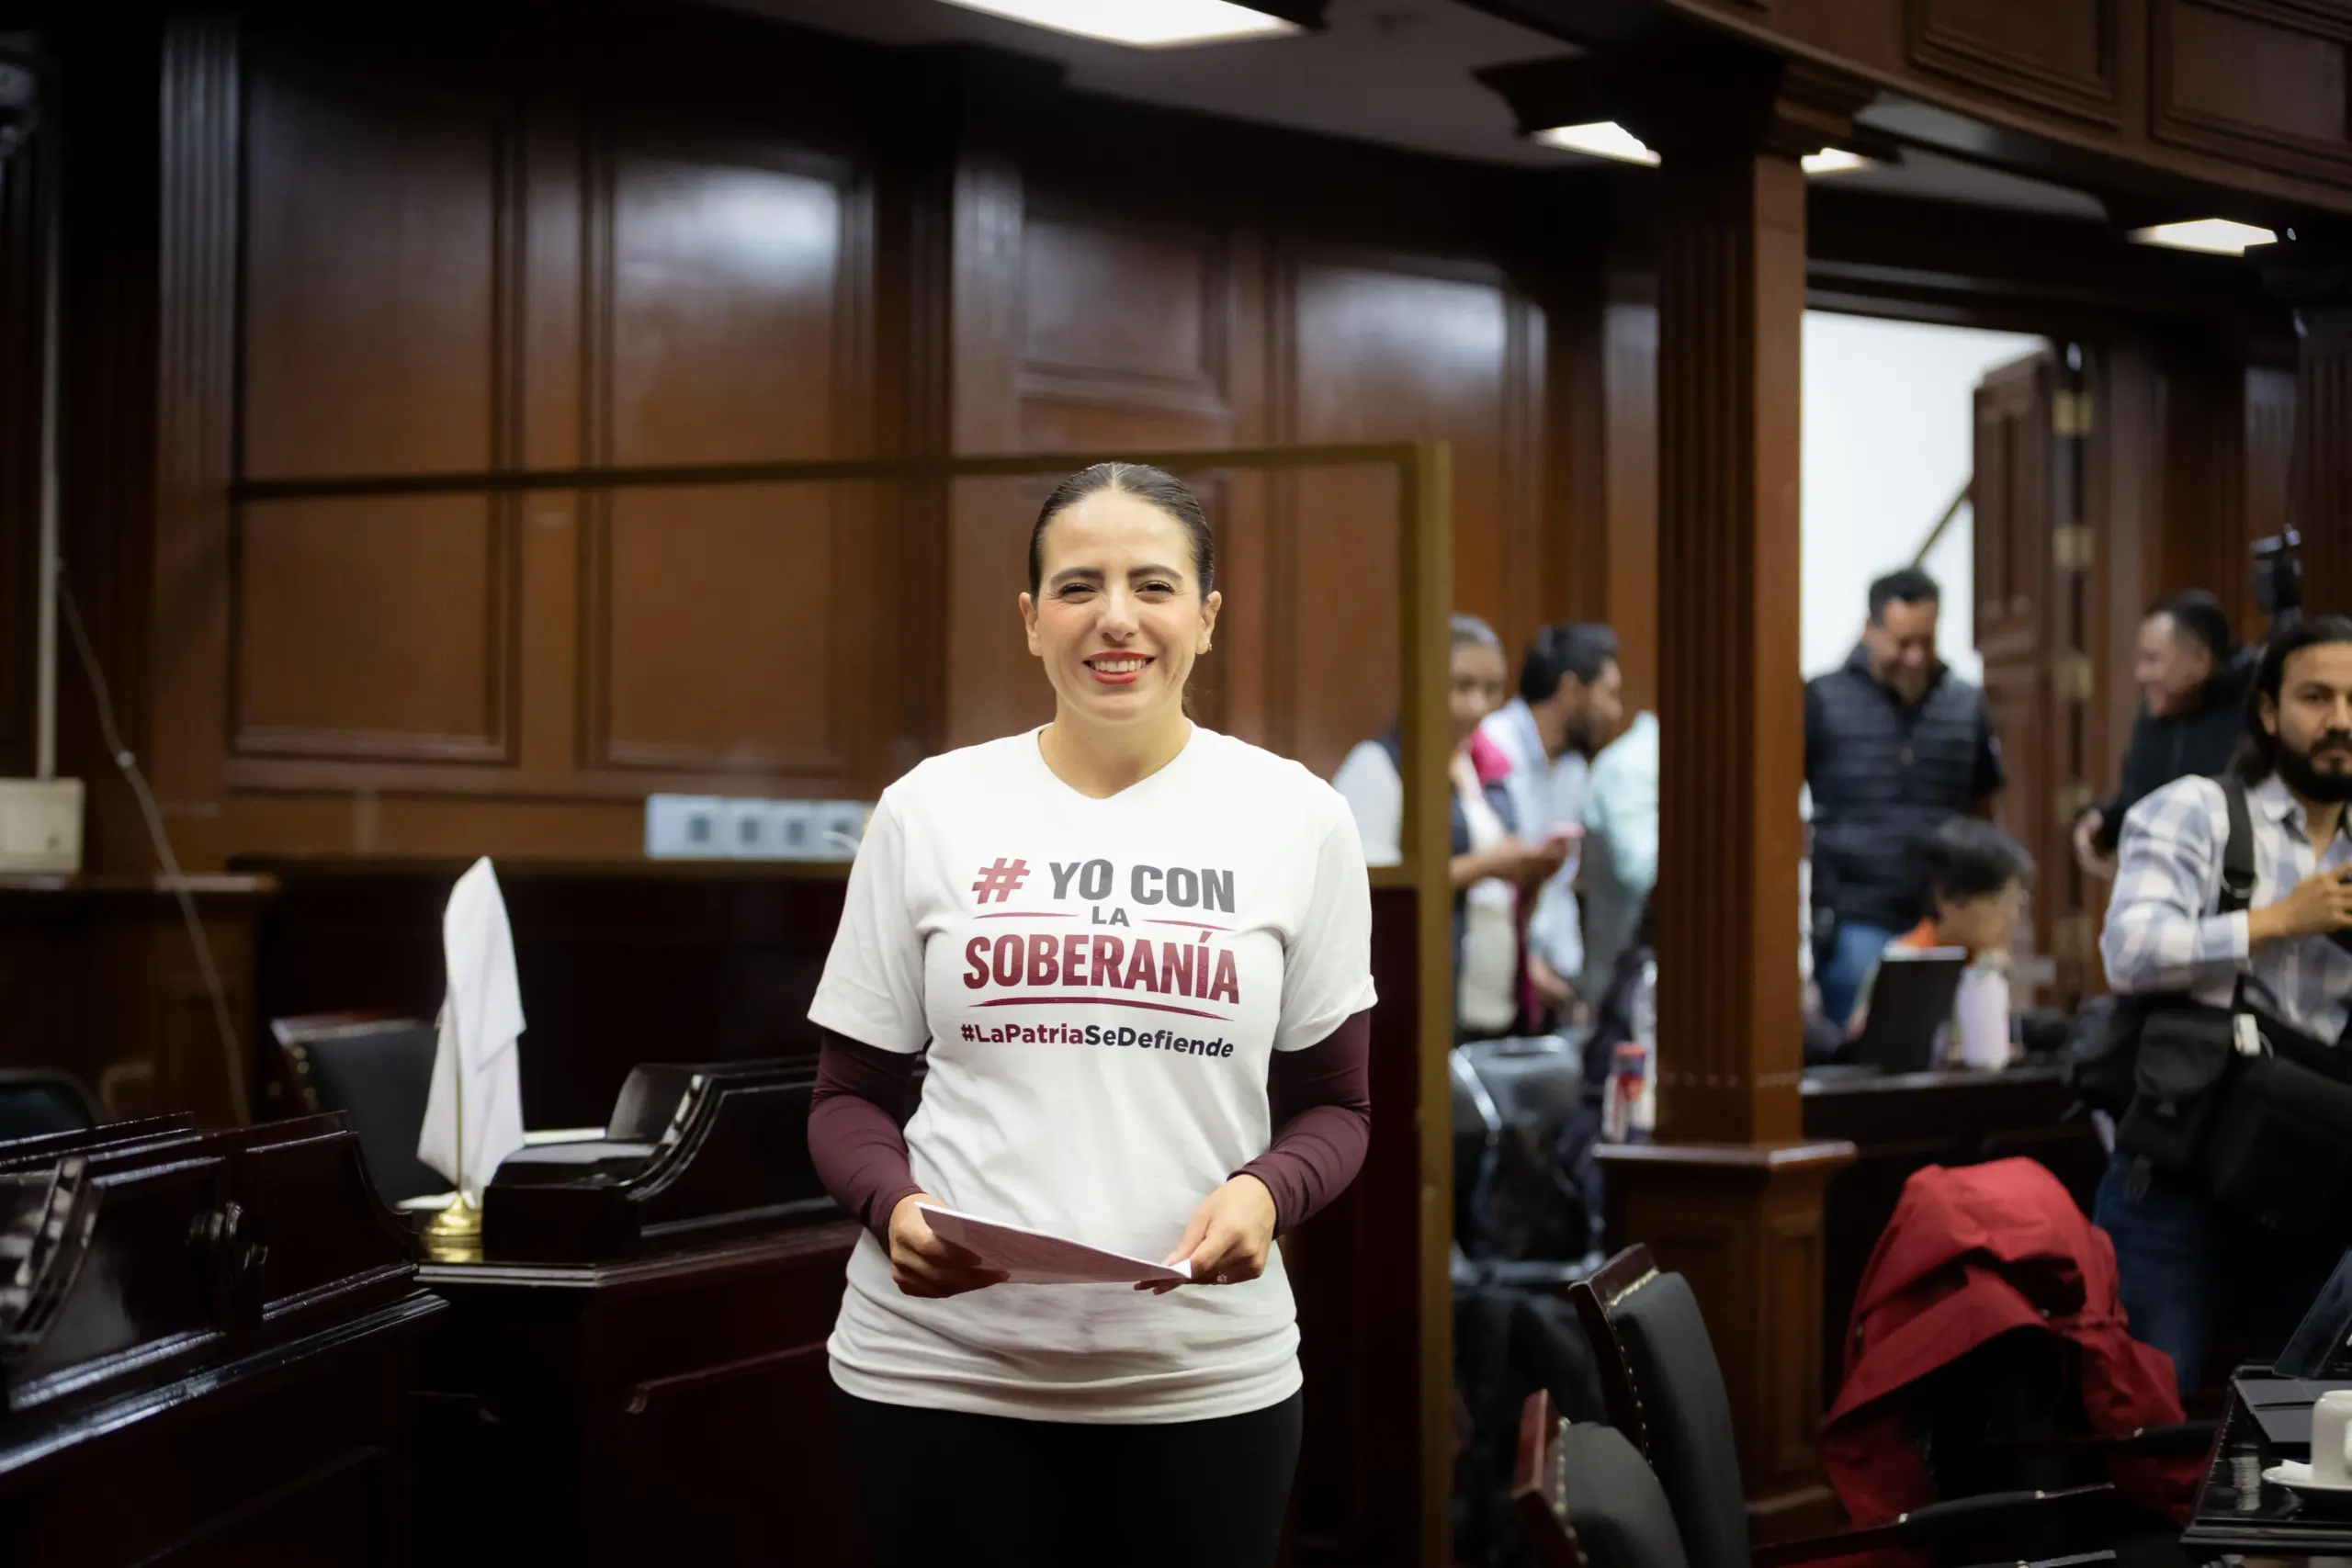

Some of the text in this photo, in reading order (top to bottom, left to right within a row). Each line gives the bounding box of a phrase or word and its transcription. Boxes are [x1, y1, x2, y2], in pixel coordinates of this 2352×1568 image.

[972, 857, 1235, 913] # YO CON
[1091, 906, 1130, 928] LA
[963, 931, 1239, 1004] SOBERANÍA
[961, 1023, 1235, 1058] #LaPatriaSeDefiende
